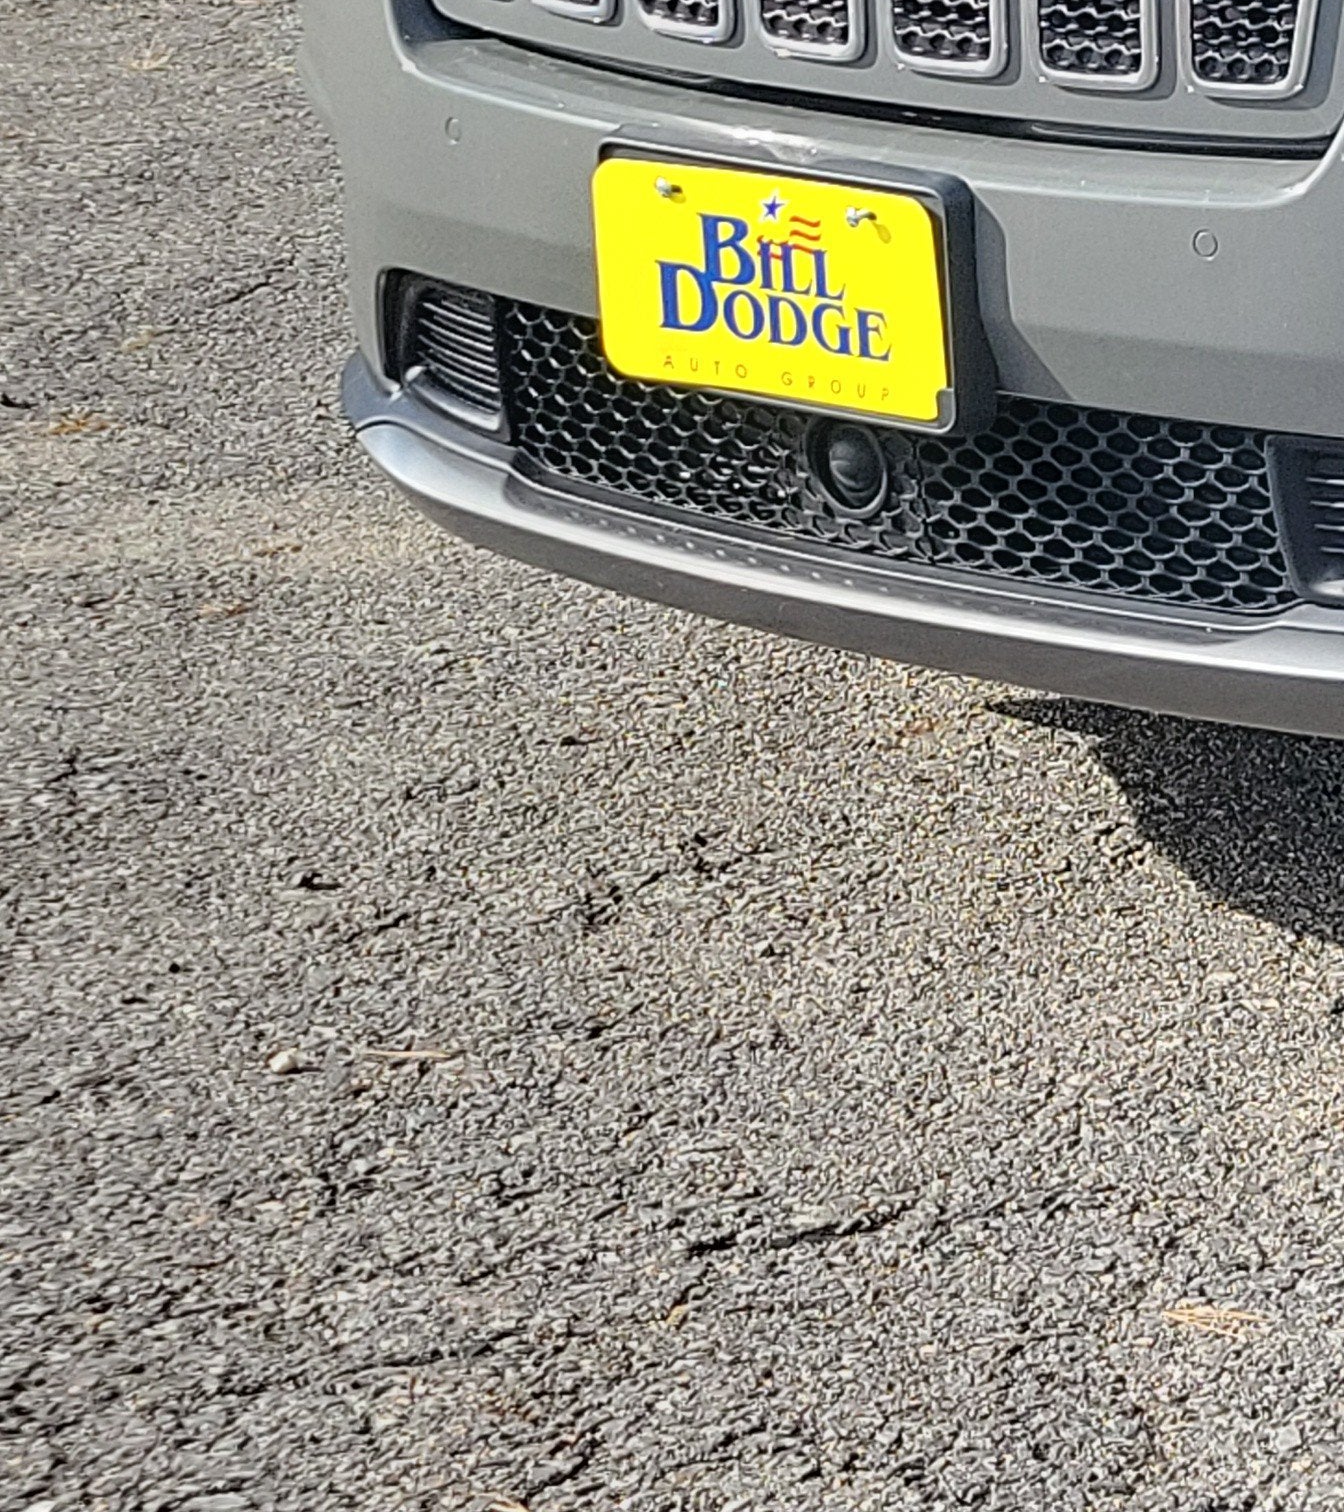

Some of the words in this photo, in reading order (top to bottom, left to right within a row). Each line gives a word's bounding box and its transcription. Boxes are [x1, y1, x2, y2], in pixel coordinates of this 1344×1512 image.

[655, 260, 893, 362] DODGE
[663, 355, 748, 380] AUTO
[781, 371, 891, 401] GROUP
